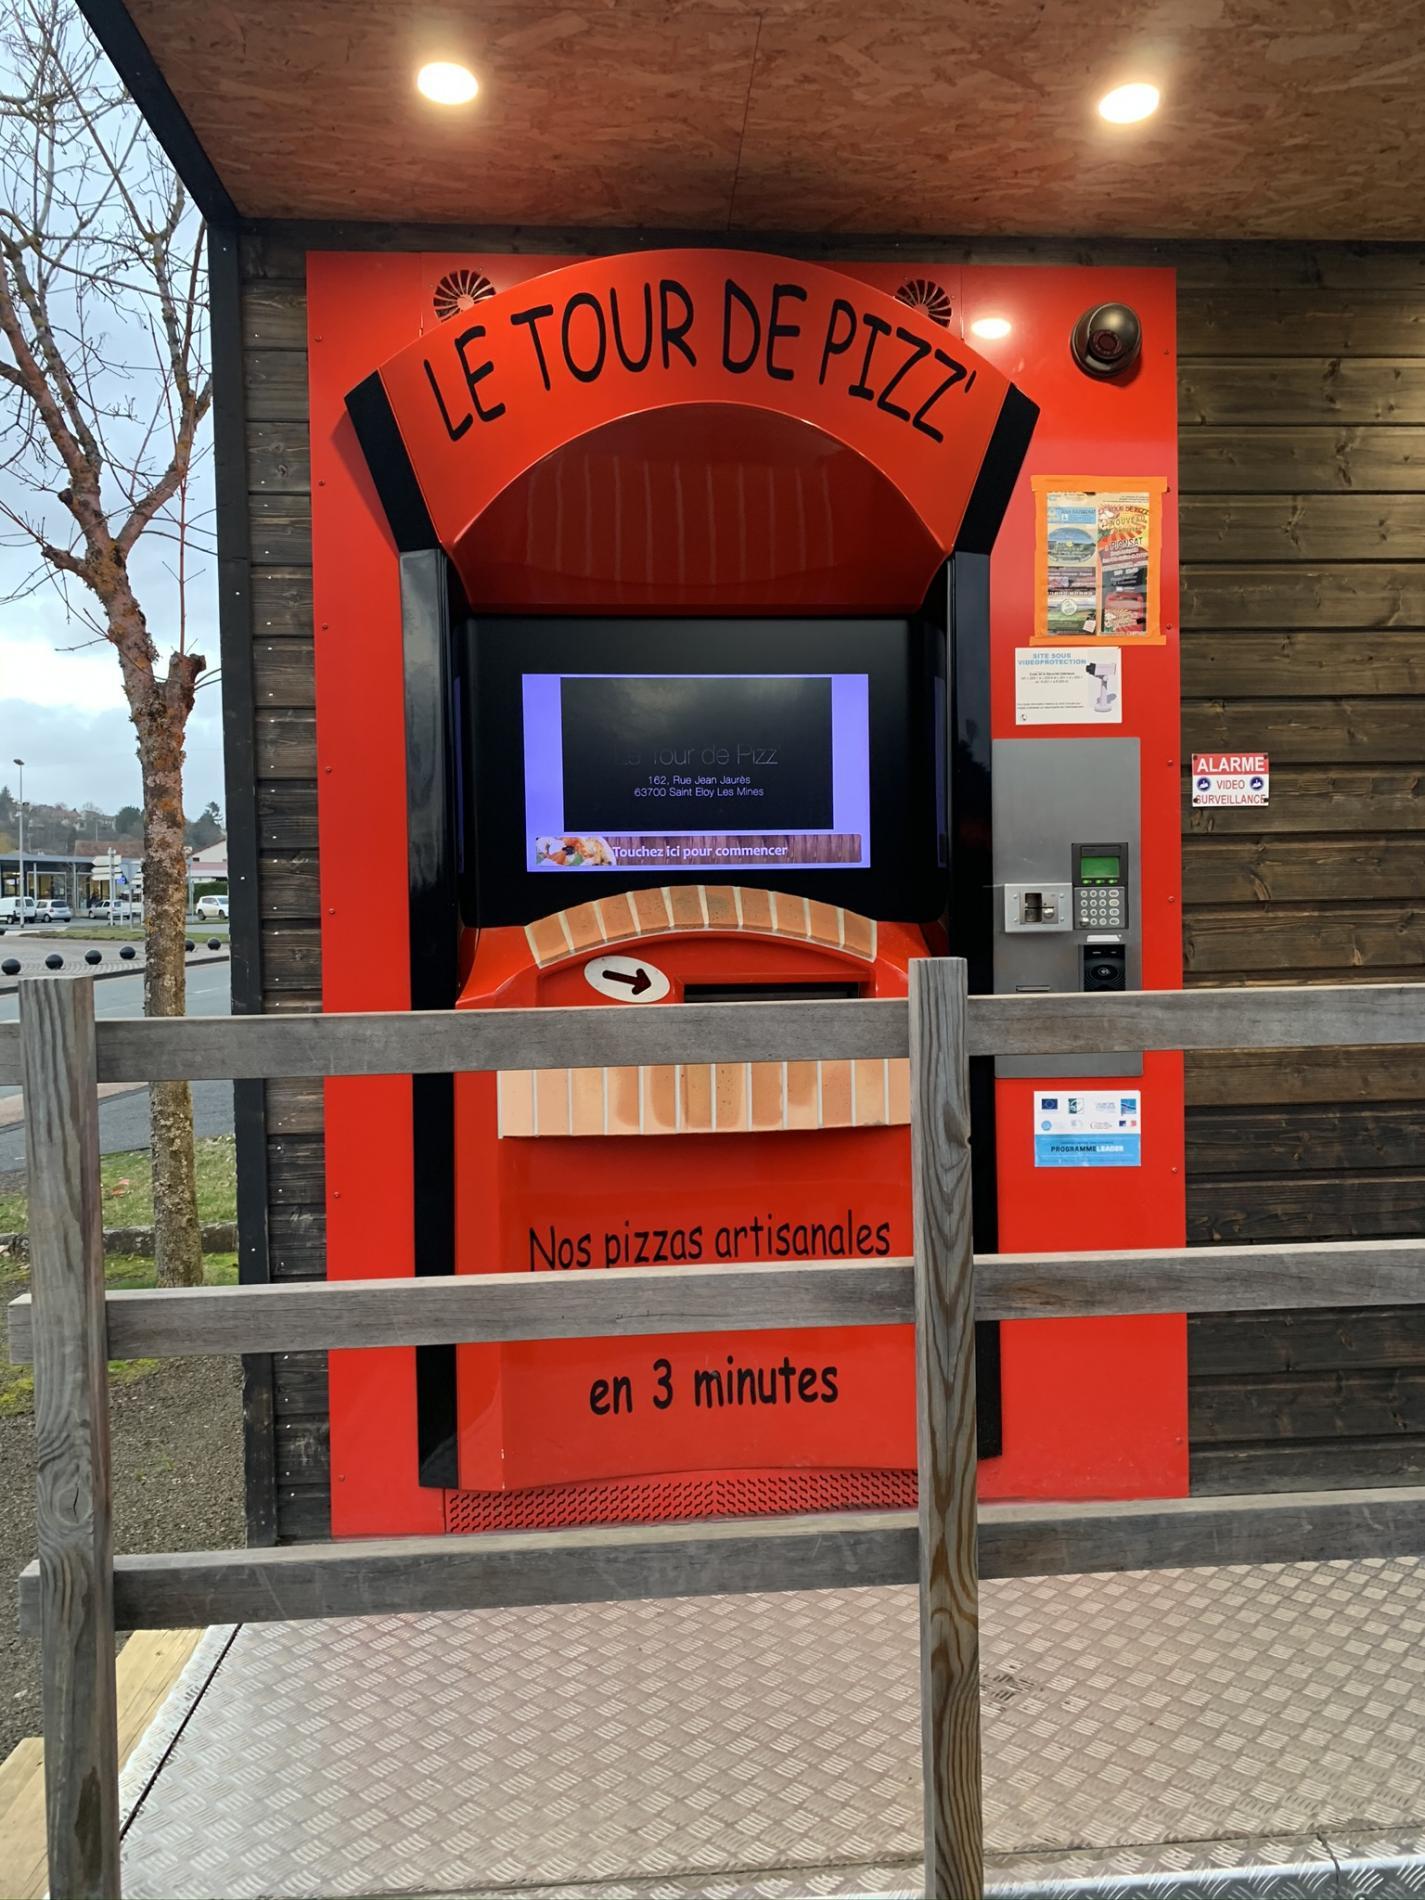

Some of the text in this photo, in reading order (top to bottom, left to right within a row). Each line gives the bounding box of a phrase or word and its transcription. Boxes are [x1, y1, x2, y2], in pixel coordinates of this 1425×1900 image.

[423, 278, 977, 444] LE TOUR DE PIZZ'
[701, 743, 730, 765] de
[1196, 756, 1265, 773] ALARME
[649, 775, 751, 787] 162, Rue Jean Jaurès
[1216, 779, 1246, 790] VIDEO
[634, 787, 667, 797] 63700
[669, 787, 692, 797] Saint
[717, 787, 734, 797] Les
[736, 787, 764, 797] Mines
[1195, 794, 1266, 805] SURVEILLANCE
[613, 844, 788, 860] Touchez ici pour commencer
[529, 1209, 890, 1272] Nos pizzas artisanales
[589, 1355, 838, 1416] en 3 minutes
